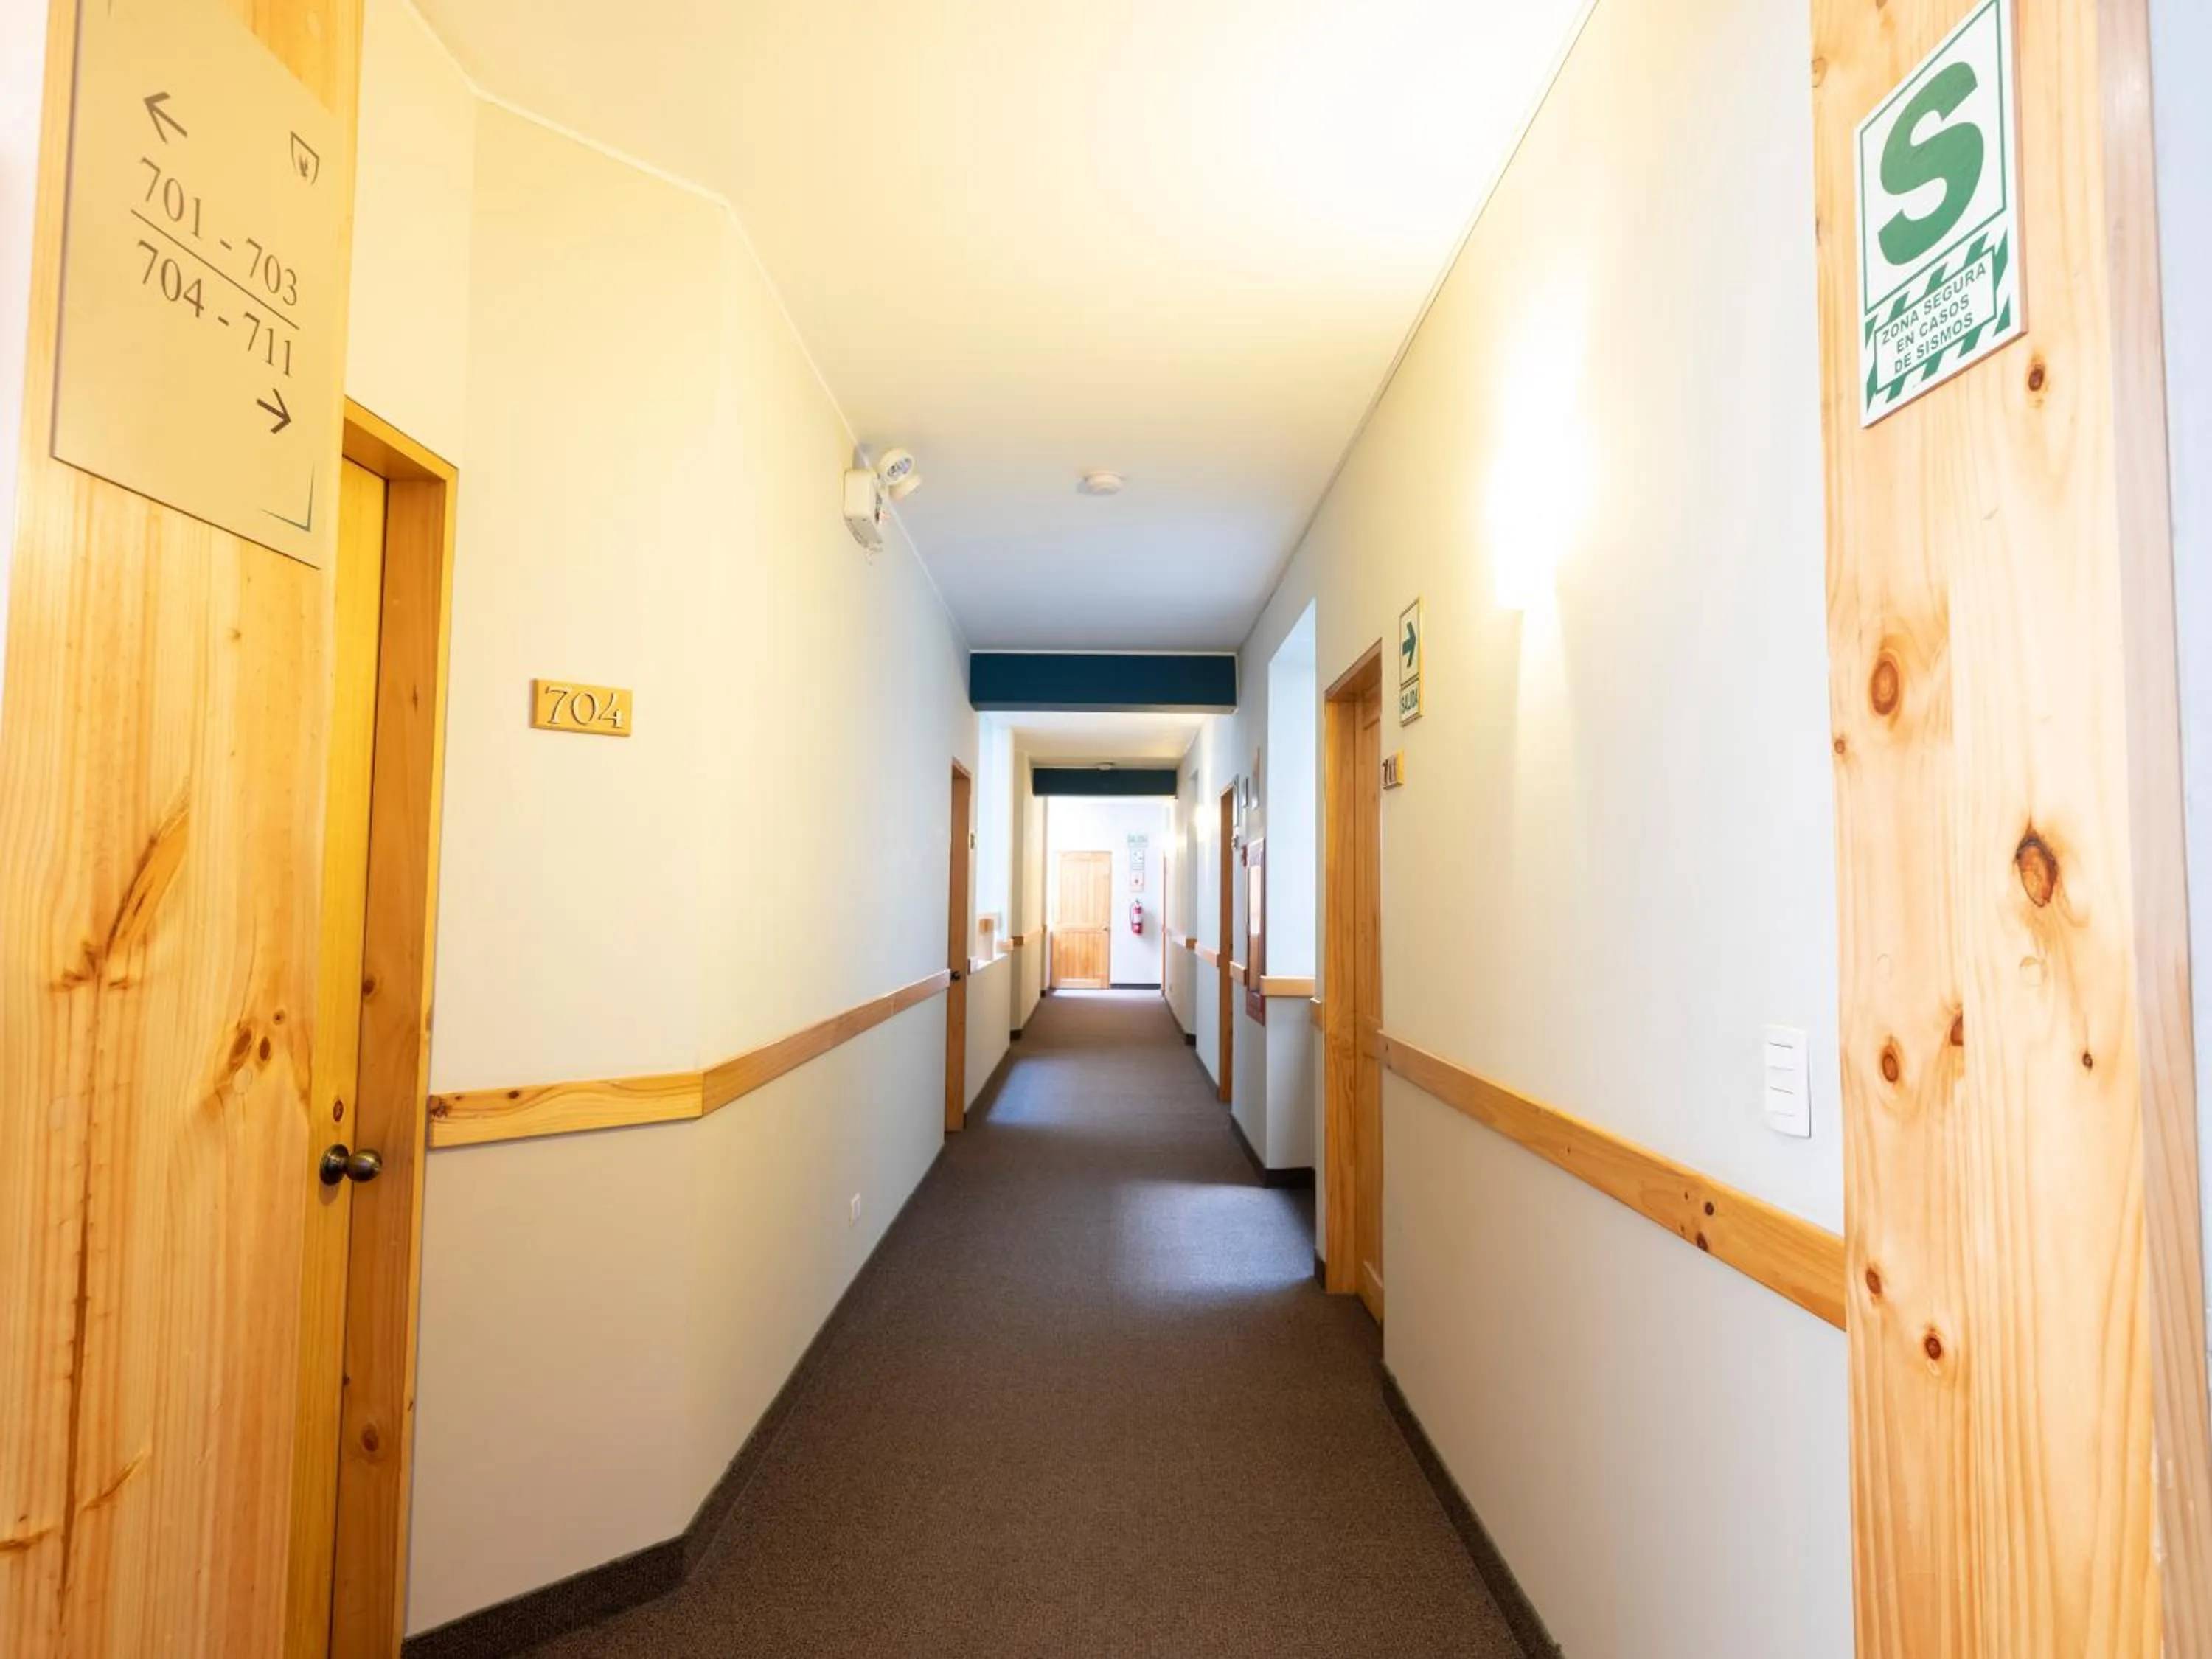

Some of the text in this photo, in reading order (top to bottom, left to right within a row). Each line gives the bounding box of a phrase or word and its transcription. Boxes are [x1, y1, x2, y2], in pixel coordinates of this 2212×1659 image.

[1878, 61, 1983, 265] S
[140, 156, 201, 237] 701
[246, 237, 297, 306] 703
[138, 240, 204, 318] 704
[243, 311, 292, 378] 711
[1882, 262, 1986, 345] ZONA SEGURA
[1894, 312, 1973, 374] DE SISMOS
[1896, 294, 1969, 354] EN CASOS
[544, 685, 624, 728] 704
